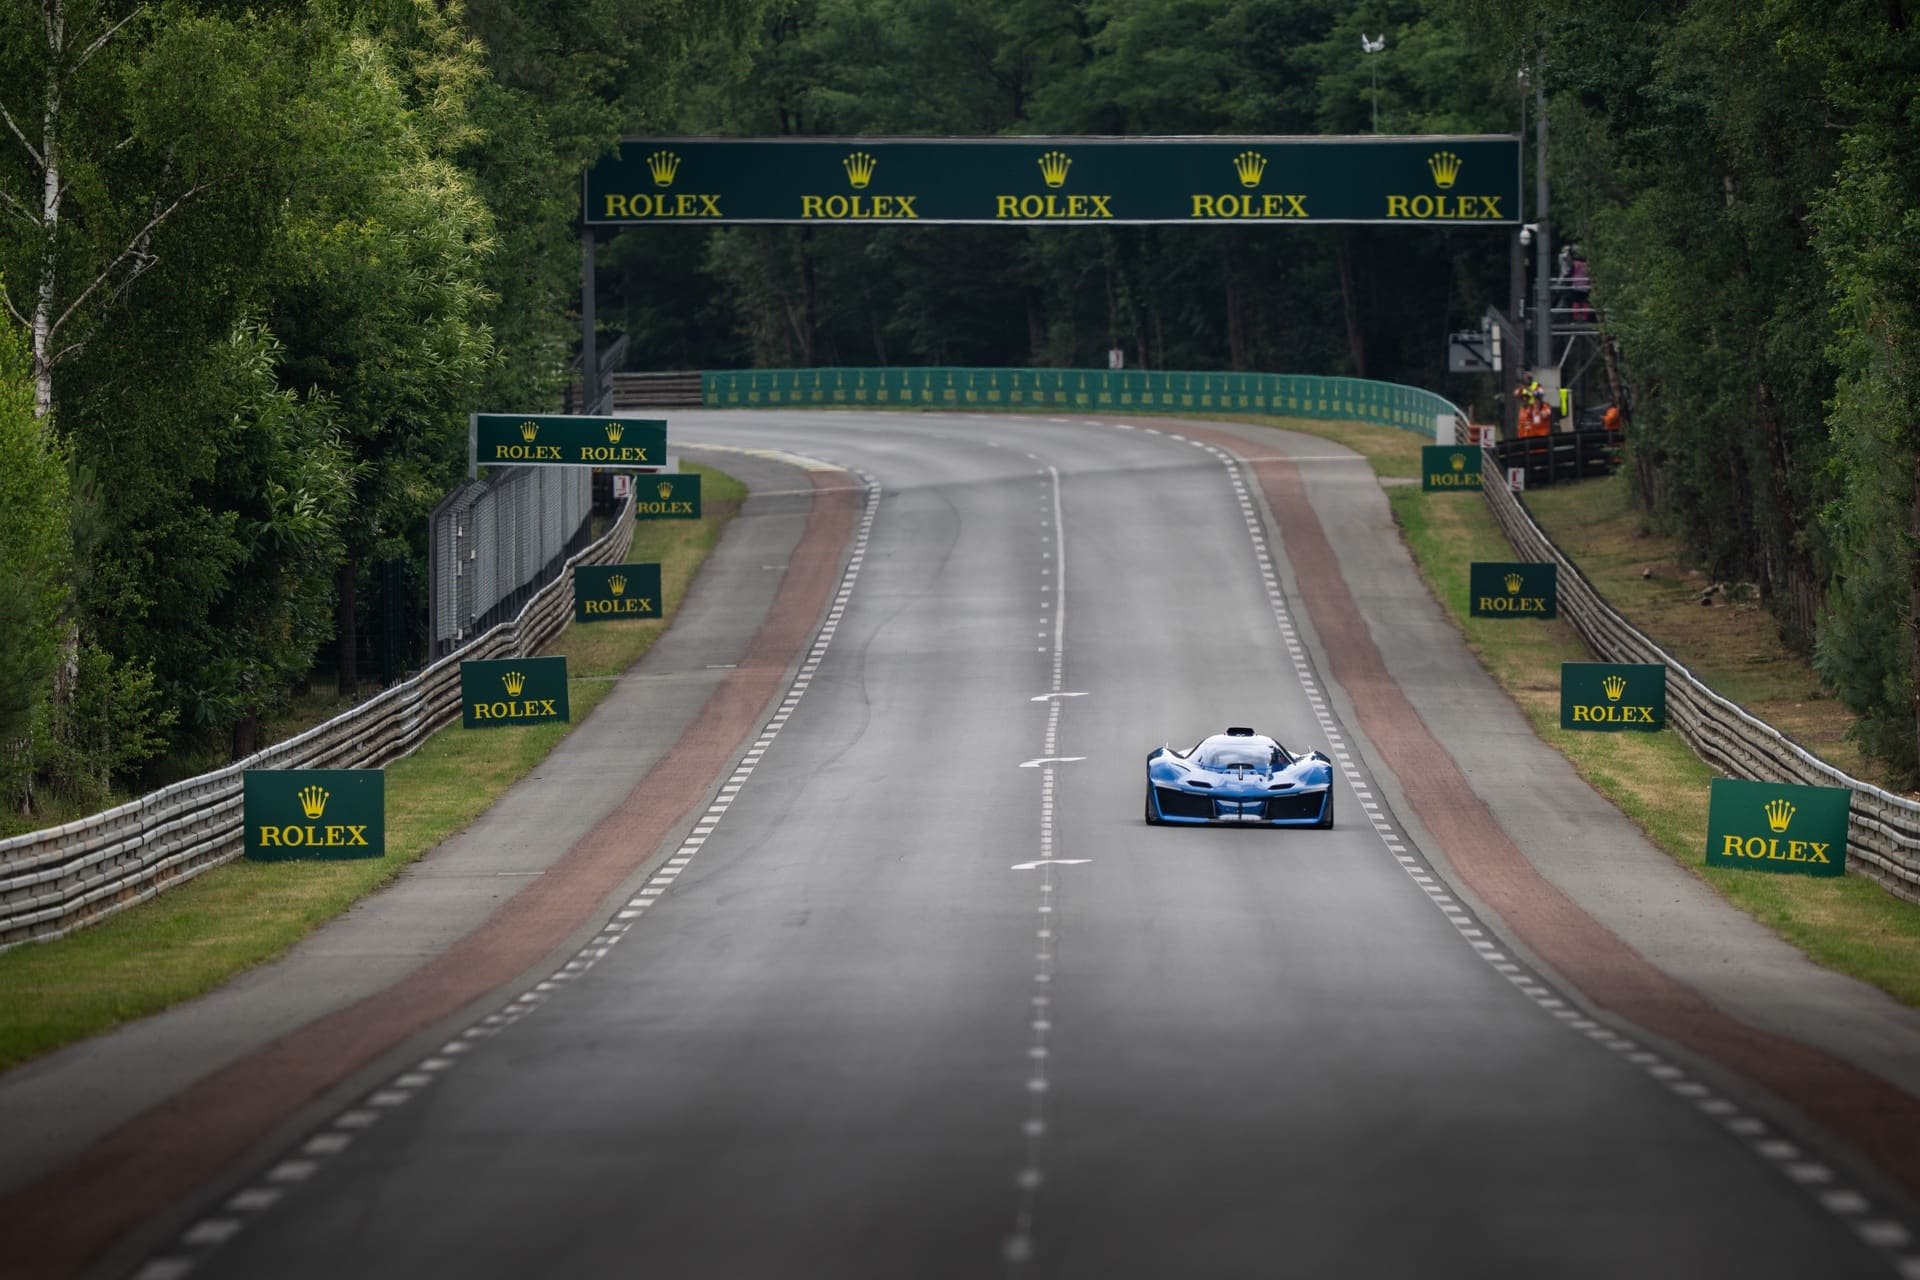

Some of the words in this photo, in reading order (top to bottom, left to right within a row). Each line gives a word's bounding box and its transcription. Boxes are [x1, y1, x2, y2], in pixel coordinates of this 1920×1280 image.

[605, 194, 723, 218] ROLEX
[801, 195, 918, 219] ROLEX
[996, 195, 1114, 219] ROLEX
[1191, 195, 1309, 218] ROLEX
[1386, 195, 1503, 219] ROLEX
[495, 445, 562, 459] ROLEX
[580, 447, 647, 461] ROLEX
[638, 502, 693, 513] ROLEX
[584, 598, 652, 613] ROLEX
[1479, 597, 1546, 612] ROLEX
[473, 699, 557, 720] ROLEX
[1573, 704, 1655, 723] ROLEX
[259, 825, 369, 847] ROLEX
[1721, 834, 1832, 865] ROLEX
